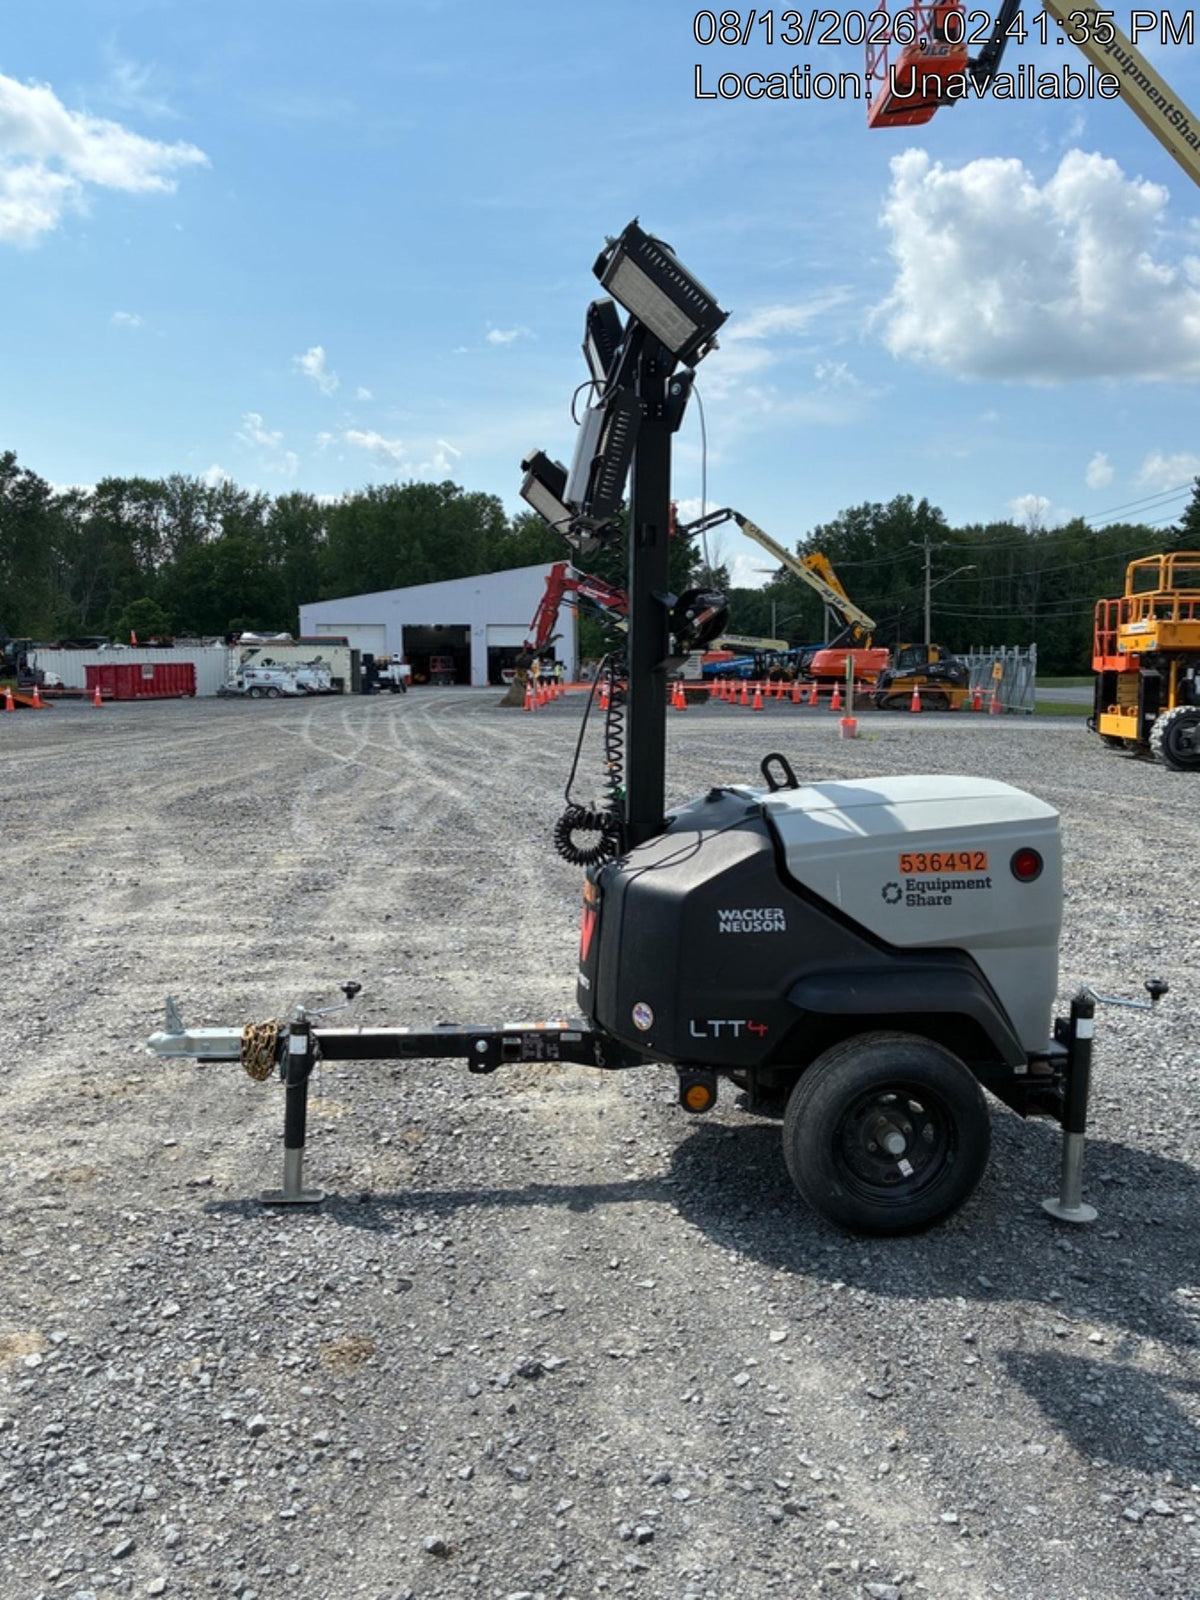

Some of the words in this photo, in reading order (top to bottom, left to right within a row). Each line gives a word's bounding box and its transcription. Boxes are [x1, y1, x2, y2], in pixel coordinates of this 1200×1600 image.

[922, 45, 950, 56] JLG
[1098, 26, 1200, 156] EquipmentShar
[900, 852, 986, 873] 536492
[905, 877, 992, 893] Equipment
[905, 894, 952, 907] Share
[718, 908, 785, 921] WACKER
[719, 921, 786, 932] NEUSON
[690, 1020, 768, 1037] LTT4
